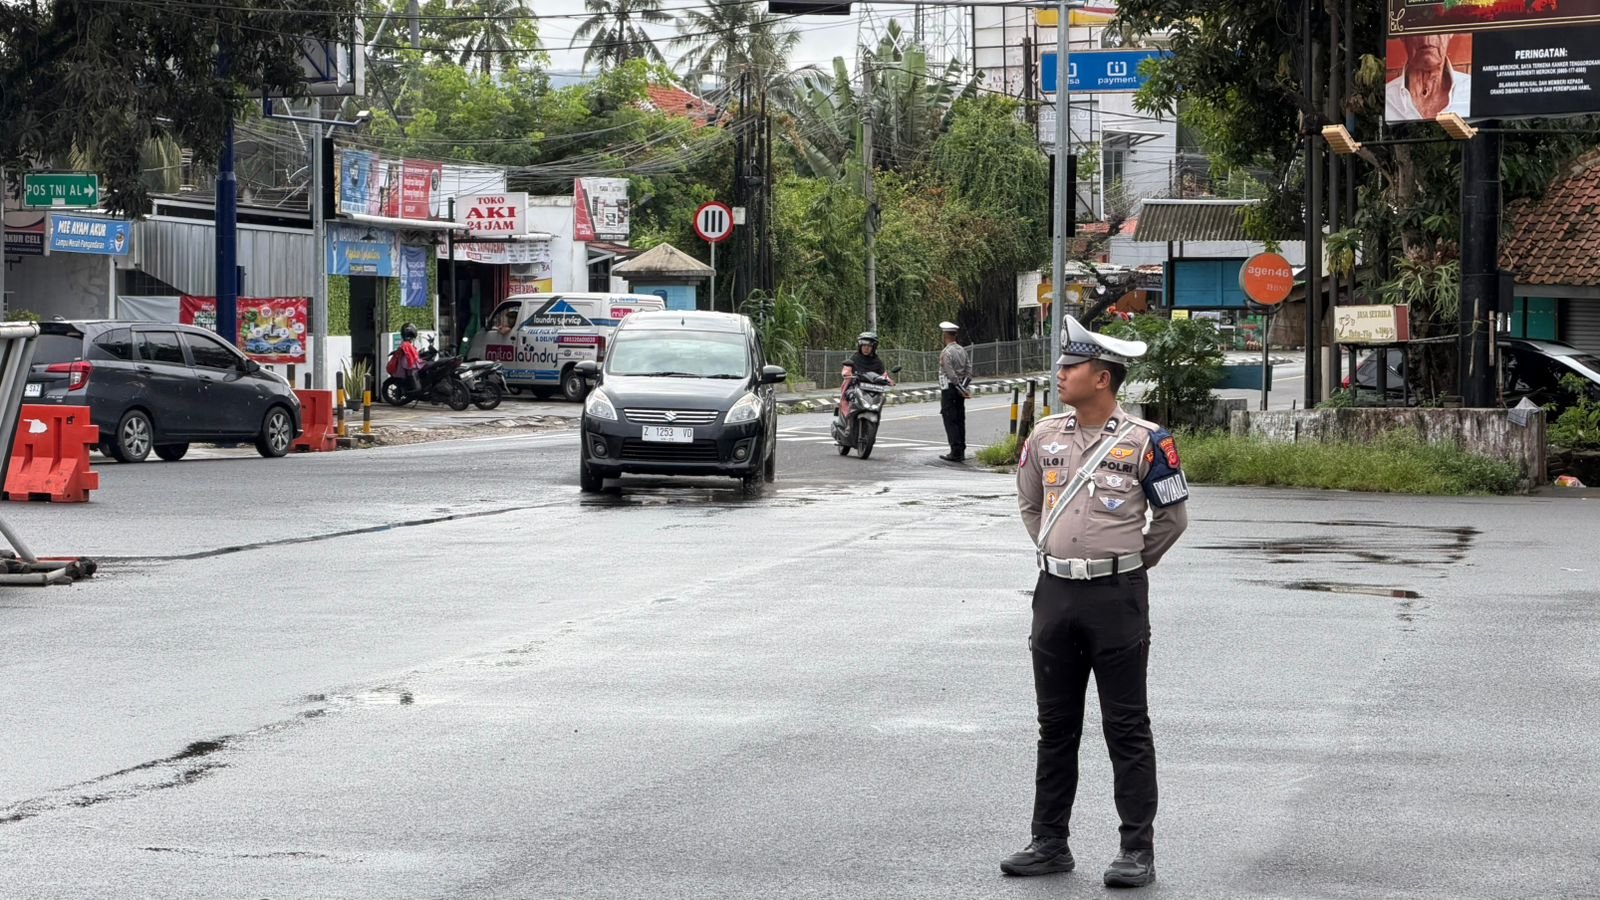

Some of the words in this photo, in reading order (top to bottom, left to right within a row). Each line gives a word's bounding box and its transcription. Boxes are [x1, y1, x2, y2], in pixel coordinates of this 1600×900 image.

[1515, 48, 1568, 60] PERINGATAN:
[1097, 76, 1136, 86] payment
[27, 184, 46, 196] POS
[50, 184, 66, 196] TNI
[70, 184, 82, 196] AL
[477, 196, 505, 205] TOKO
[465, 206, 517, 219] AKI
[58, 220, 71, 234] MIE
[71, 221, 90, 236] AYAM
[90, 222, 106, 238] AKUR
[467, 220, 482, 231] 24
[484, 220, 514, 230] JAM
[24, 234, 41, 244] CELL
[55, 238, 68, 248] Lampu
[1247, 265, 1290, 279] agen46
[533, 315, 557, 326] laundry
[557, 315, 582, 326] service
[486, 346, 514, 362] mitra
[514, 347, 558, 368] laundry
[643, 426, 649, 436] Z
[656, 427, 674, 437] 1253
[1043, 458, 1064, 467] ILGI
[1100, 461, 1133, 473] POLRI
[1153, 474, 1187, 504] WAL
